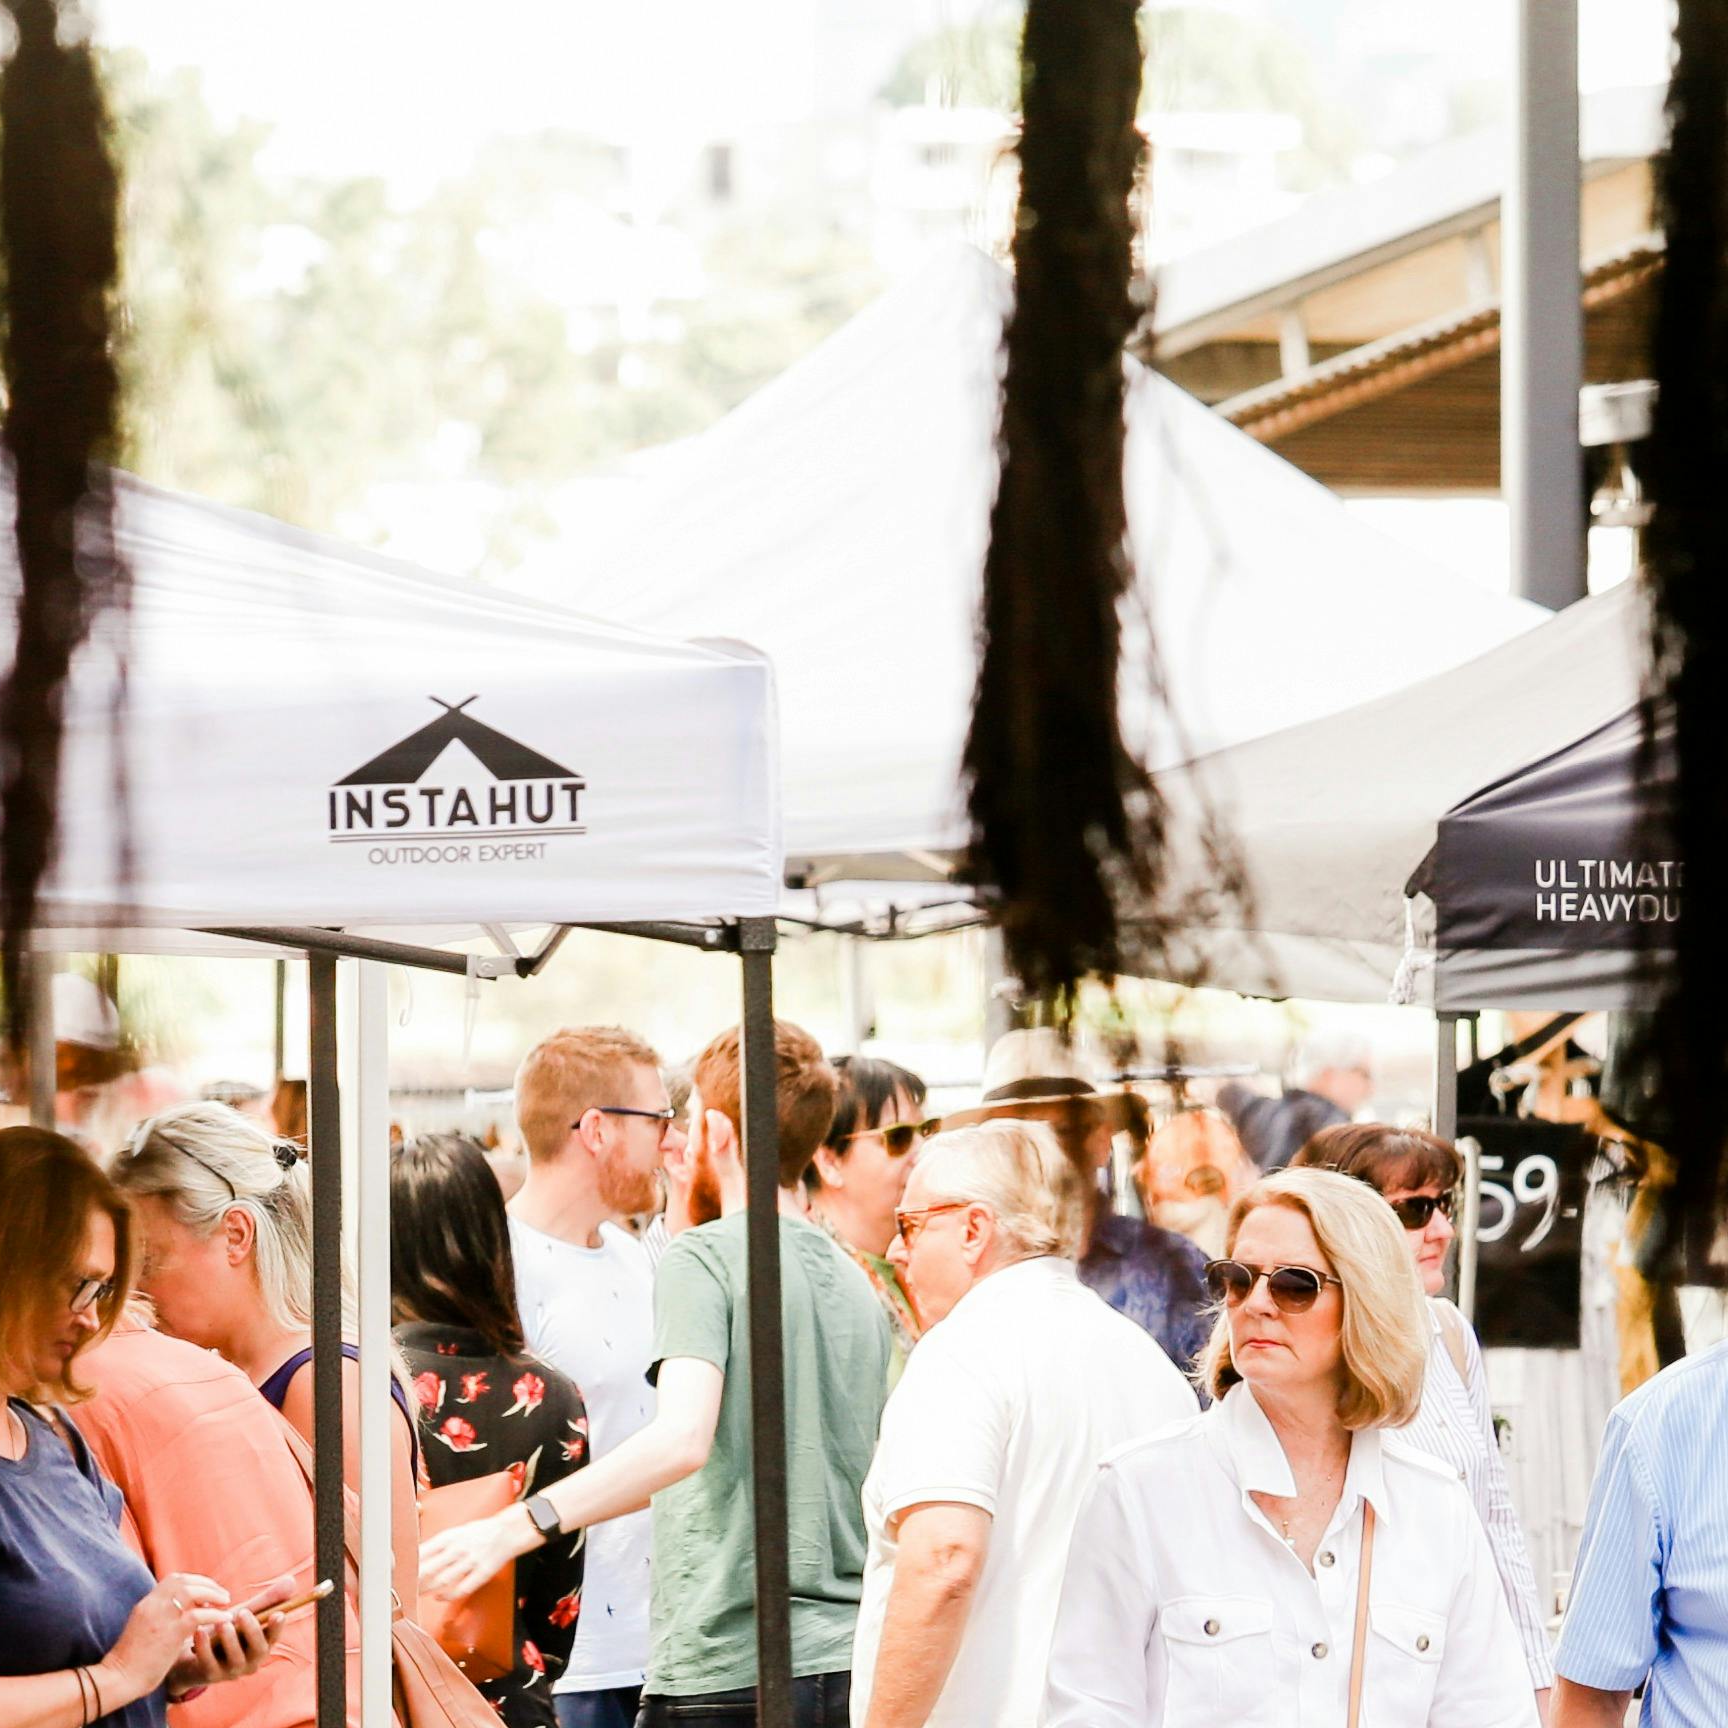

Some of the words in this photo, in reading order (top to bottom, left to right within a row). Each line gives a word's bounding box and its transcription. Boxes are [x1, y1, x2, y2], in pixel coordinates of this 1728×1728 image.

[329, 784, 586, 829] INSTAHUT
[368, 845, 471, 865] OUTDOOR
[478, 842, 547, 862] EXPERT
[1535, 892, 1682, 923] HEAVYDU
